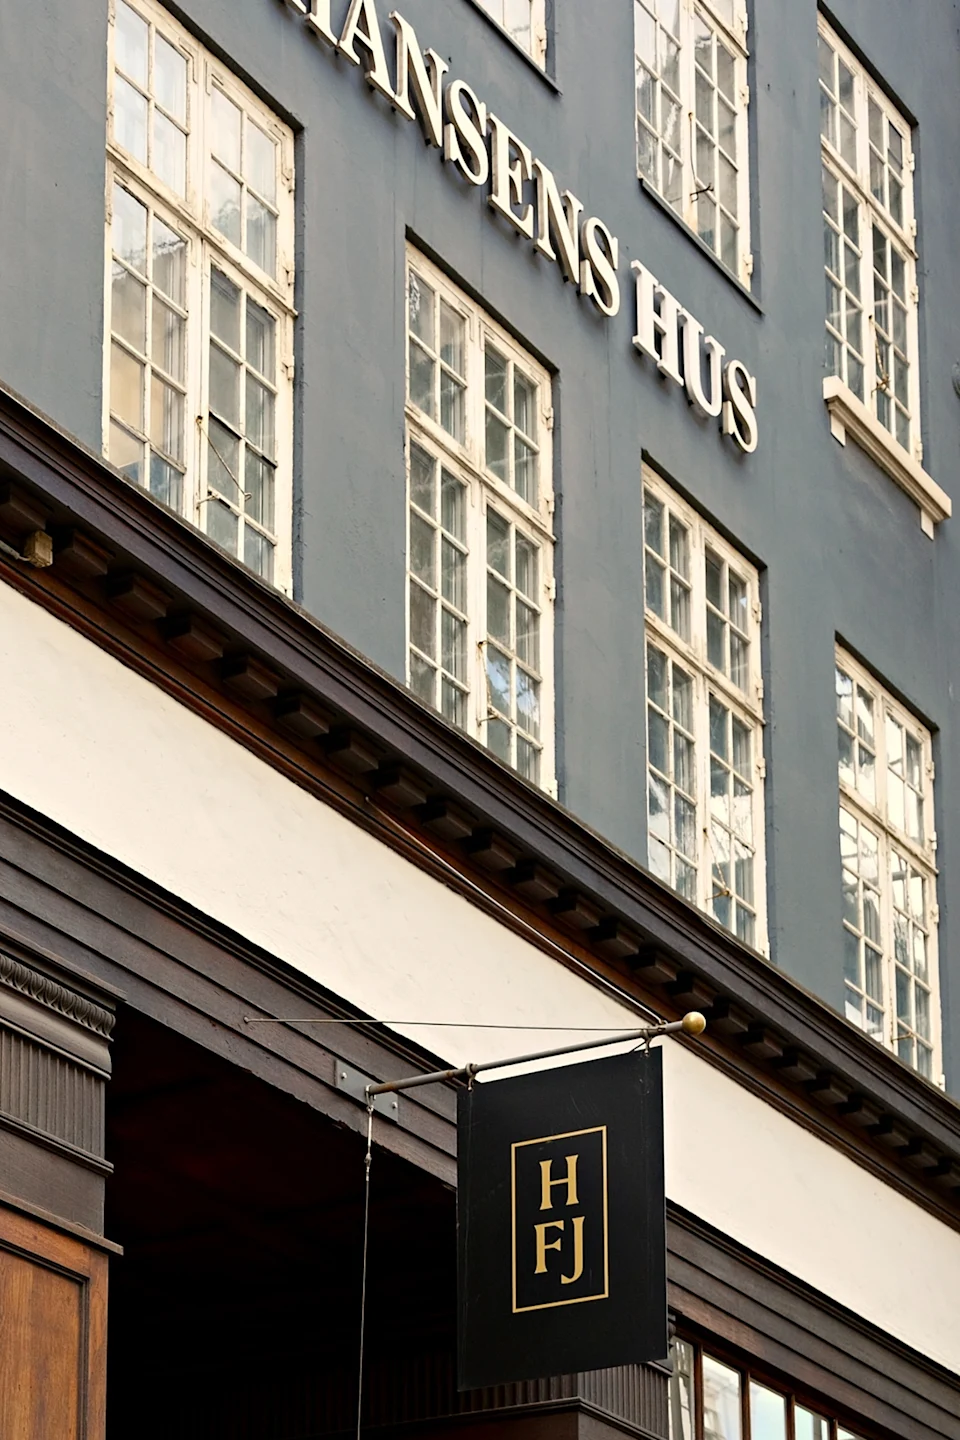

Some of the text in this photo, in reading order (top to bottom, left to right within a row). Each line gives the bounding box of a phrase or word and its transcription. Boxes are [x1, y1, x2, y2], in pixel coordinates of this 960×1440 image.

[631, 259, 758, 453] HUS
[539, 1154, 579, 1210] H
[534, 1216, 585, 1284] FJ
